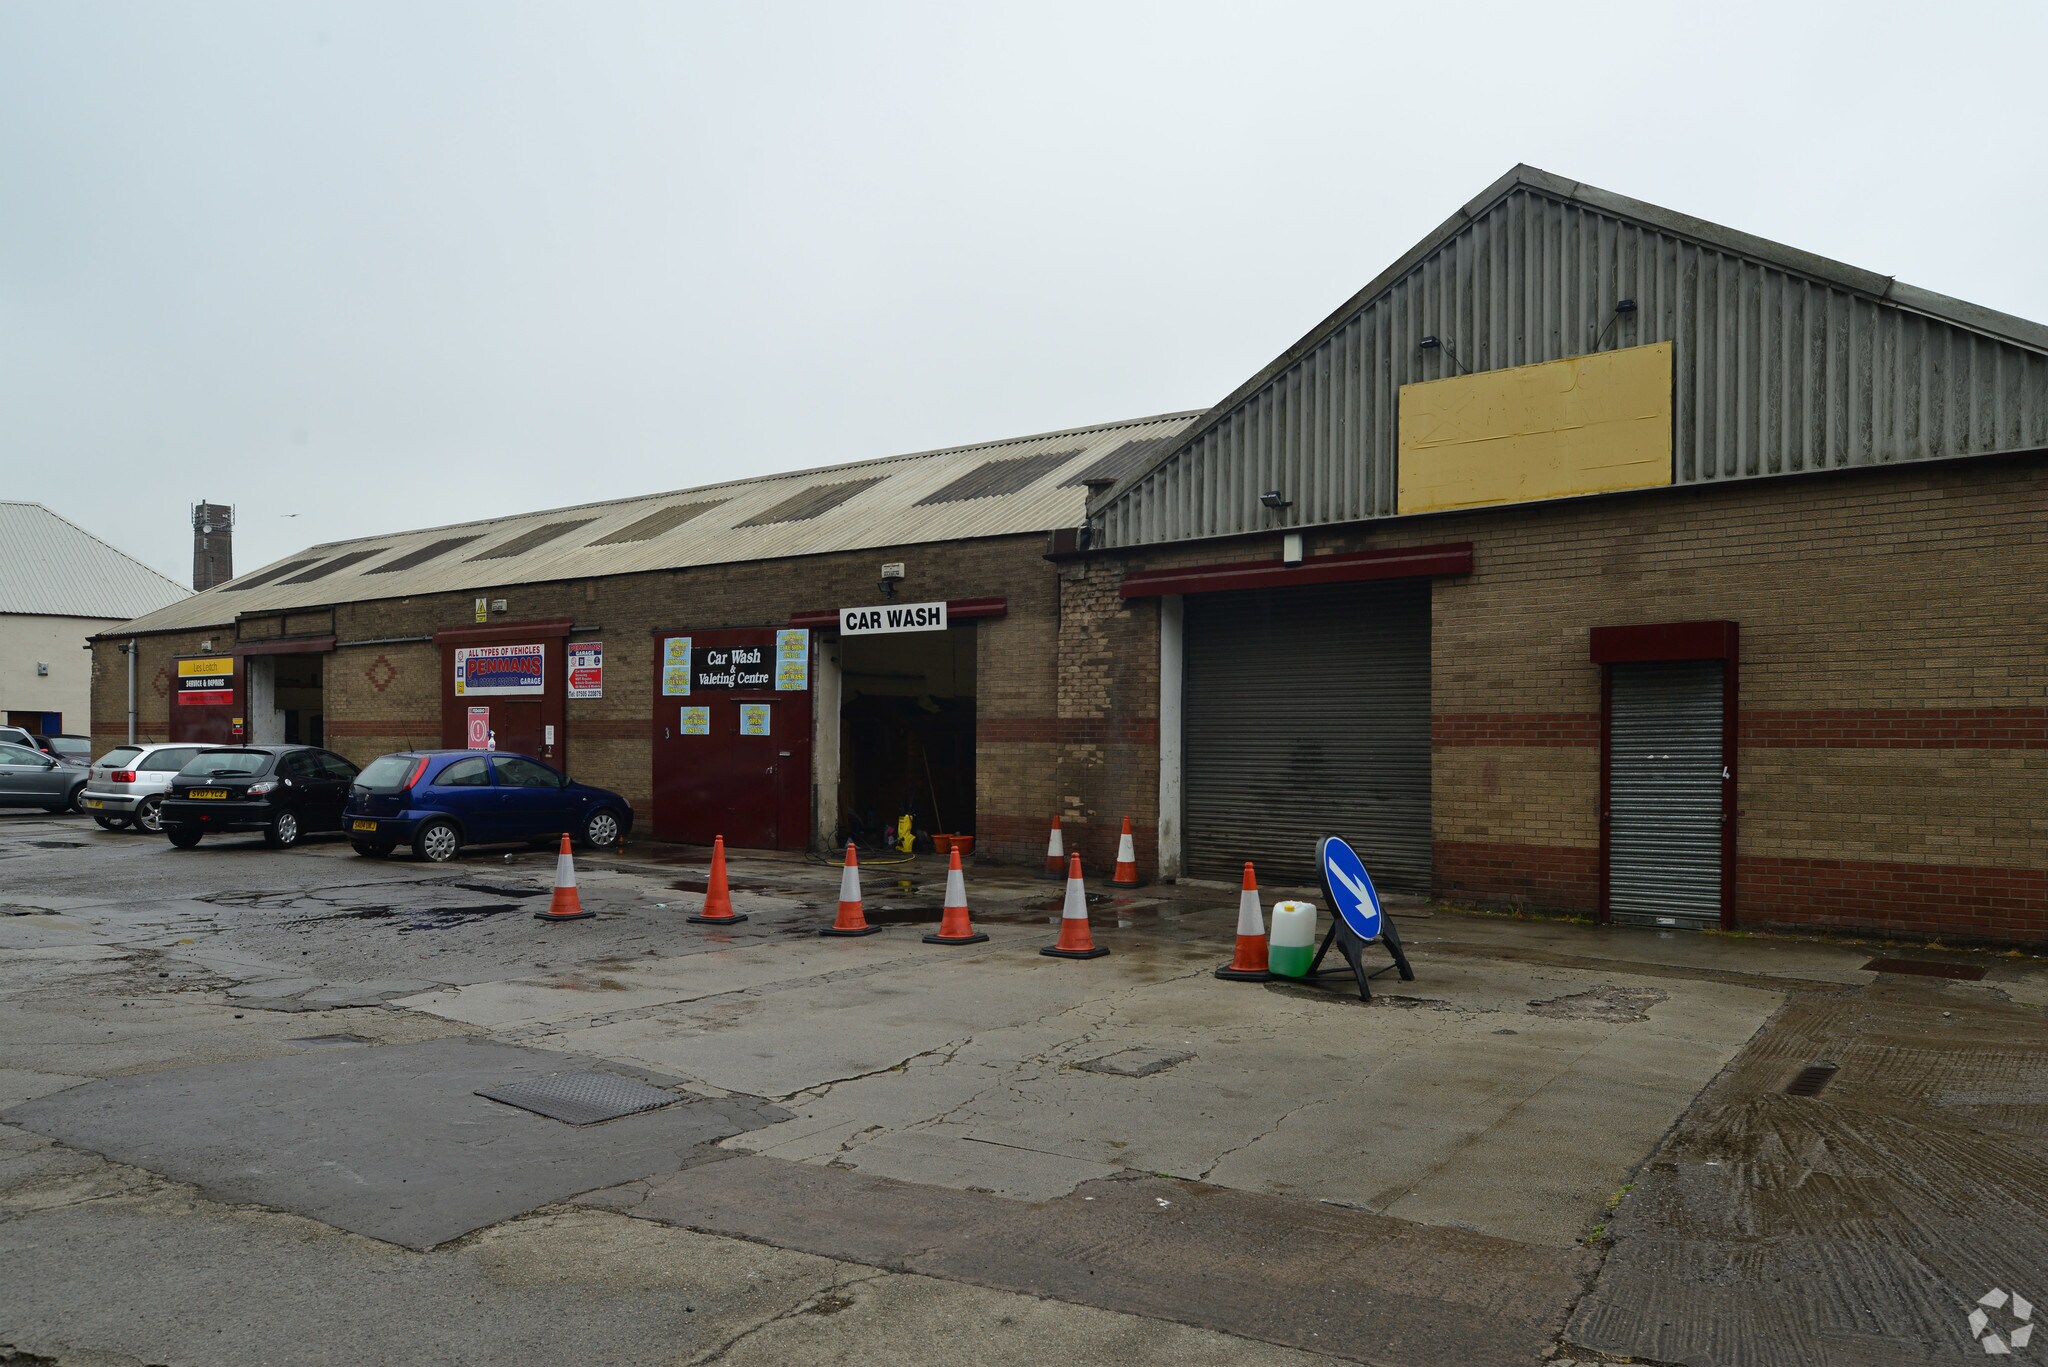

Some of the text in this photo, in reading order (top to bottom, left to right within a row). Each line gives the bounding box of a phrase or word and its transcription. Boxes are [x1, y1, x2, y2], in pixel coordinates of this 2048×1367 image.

[846, 607, 940, 630] CAR WASH
[481, 648, 499, 656] TYPES
[501, 647, 509, 655] OF
[510, 646, 540, 655] VEHICLES
[570, 643, 601, 652] PENMANS
[707, 648, 761, 665] Car Wash
[193, 662, 218, 672] Les Leitch
[467, 656, 541, 678] PENMANS
[730, 665, 737, 673] &
[185, 678, 225, 688] SERVICE & REPAIRS
[520, 677, 541, 685] GARAGE
[699, 672, 769, 688] Valeting Centre
[664, 727, 670, 740] 3
[548, 745, 552, 753] 2
[1722, 766, 1731, 779] 4
